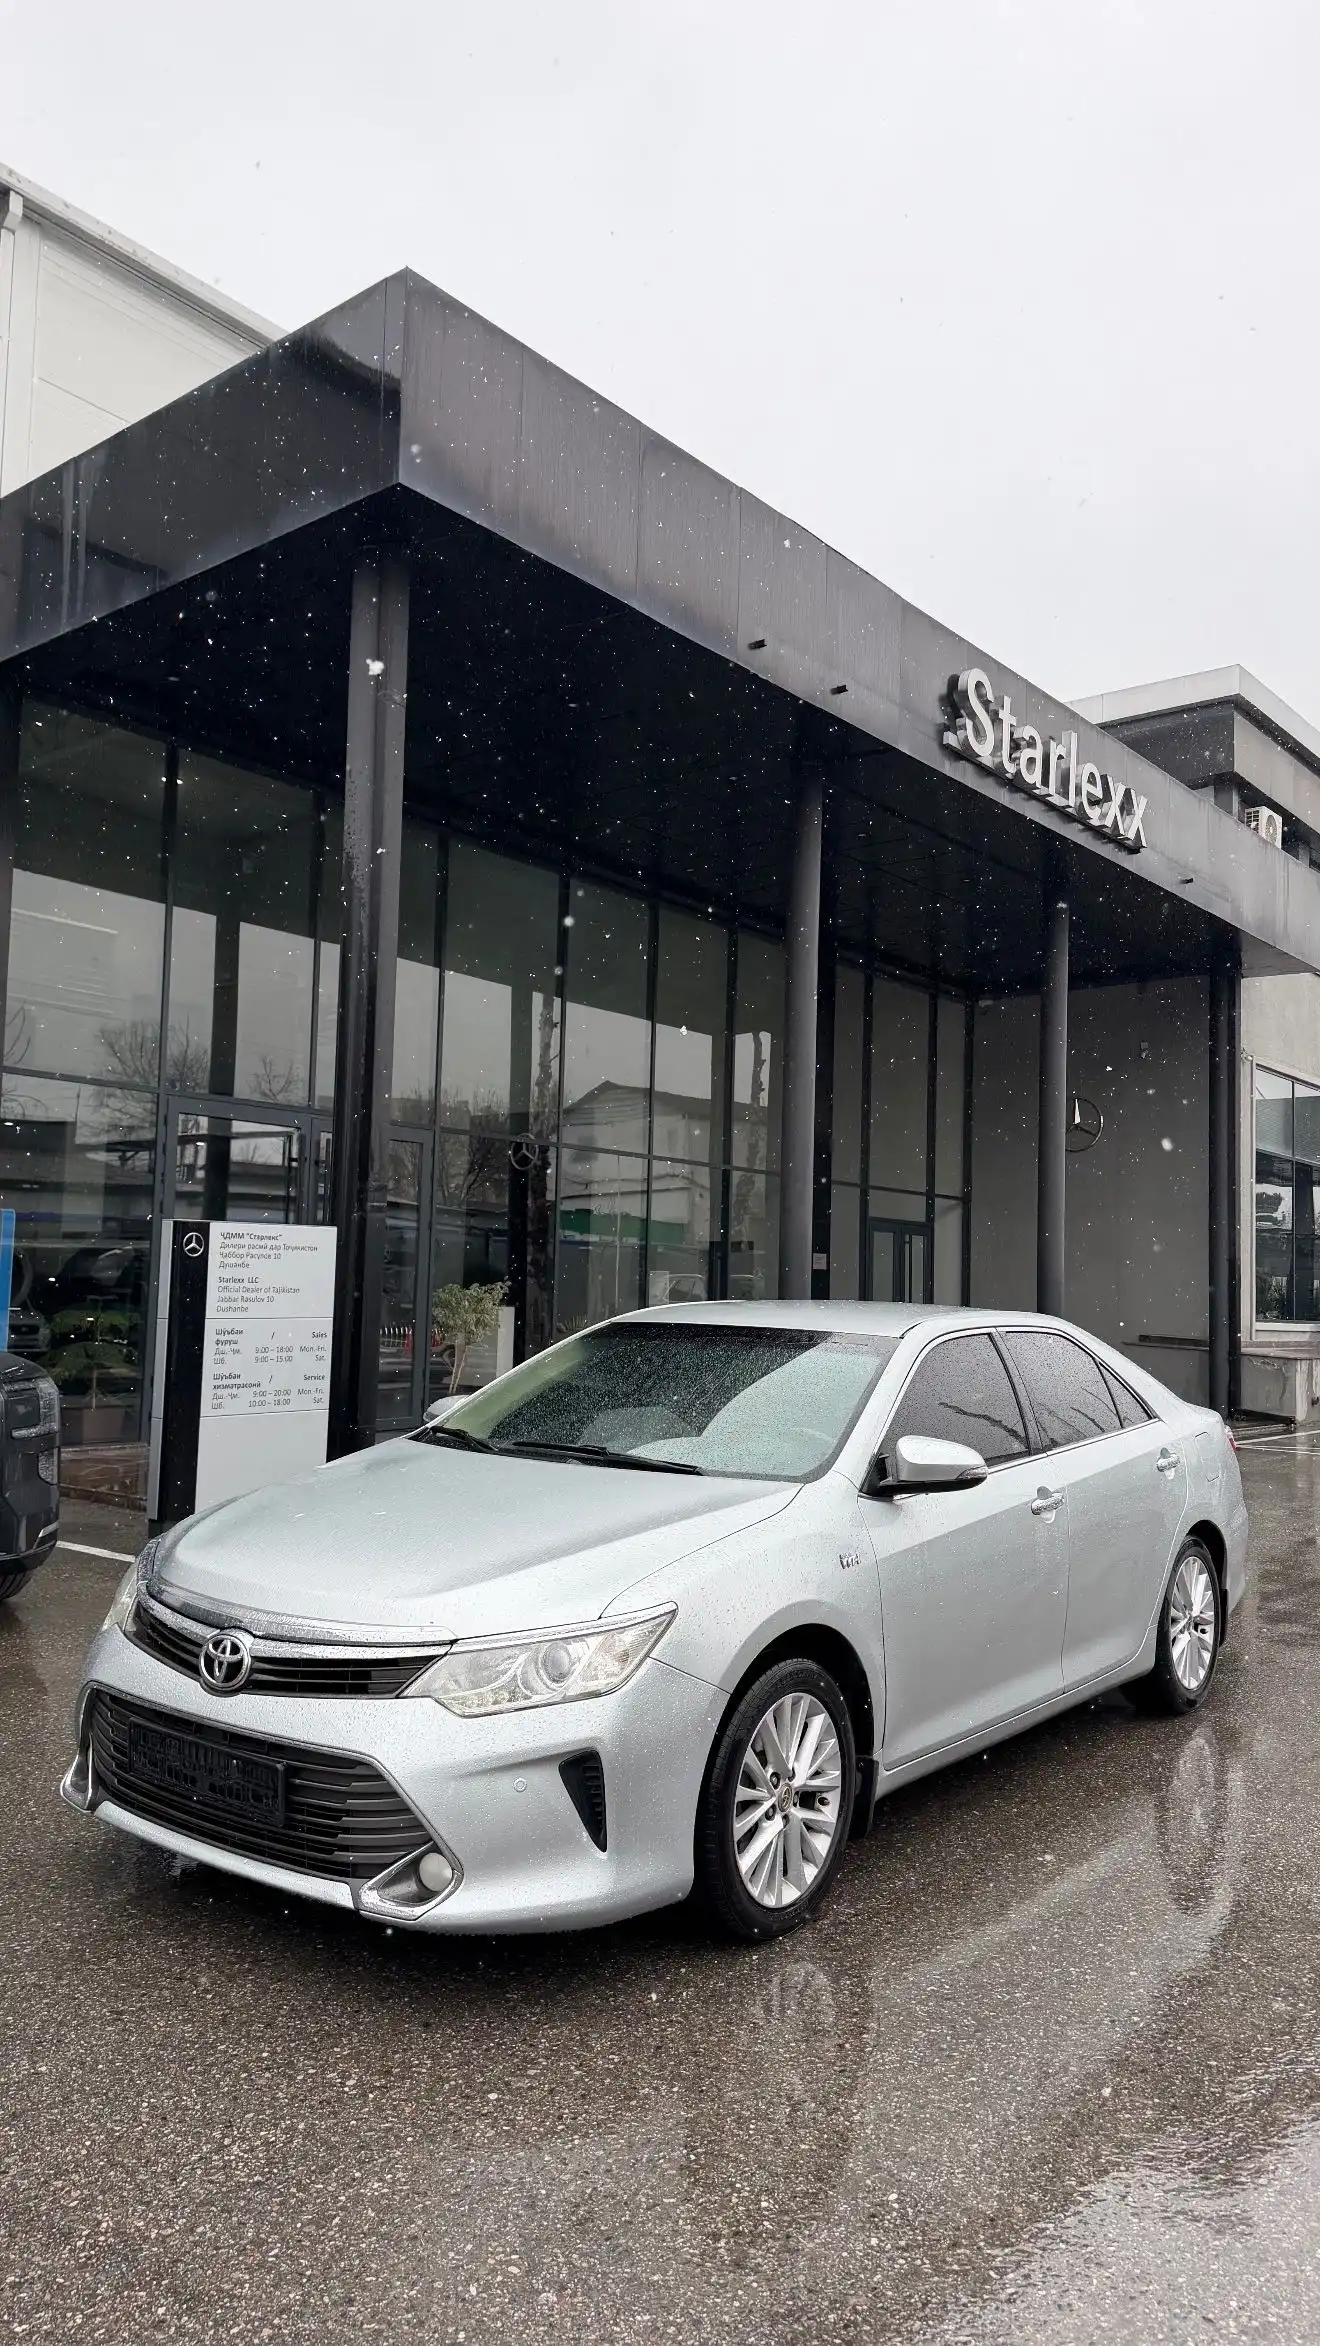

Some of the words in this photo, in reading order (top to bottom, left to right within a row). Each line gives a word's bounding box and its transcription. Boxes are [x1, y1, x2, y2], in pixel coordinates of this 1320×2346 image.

[943, 668, 1148, 849] Starlexx
[219, 1261, 250, 1270] Душанбе
[218, 1276, 245, 1284] Starlexx
[217, 1286, 241, 1294] Official
[242, 1286, 263, 1294] Dealer
[264, 1286, 271, 1294] of
[272, 1286, 300, 1295] Tajikistan
[311, 1331, 328, 1339] Sales
[252, 1390, 267, 1398] 9:00
[273, 1389, 292, 1397] 20:00
[248, 1400, 267, 1408] 10:00
[273, 1398, 291, 1406] 18:00
